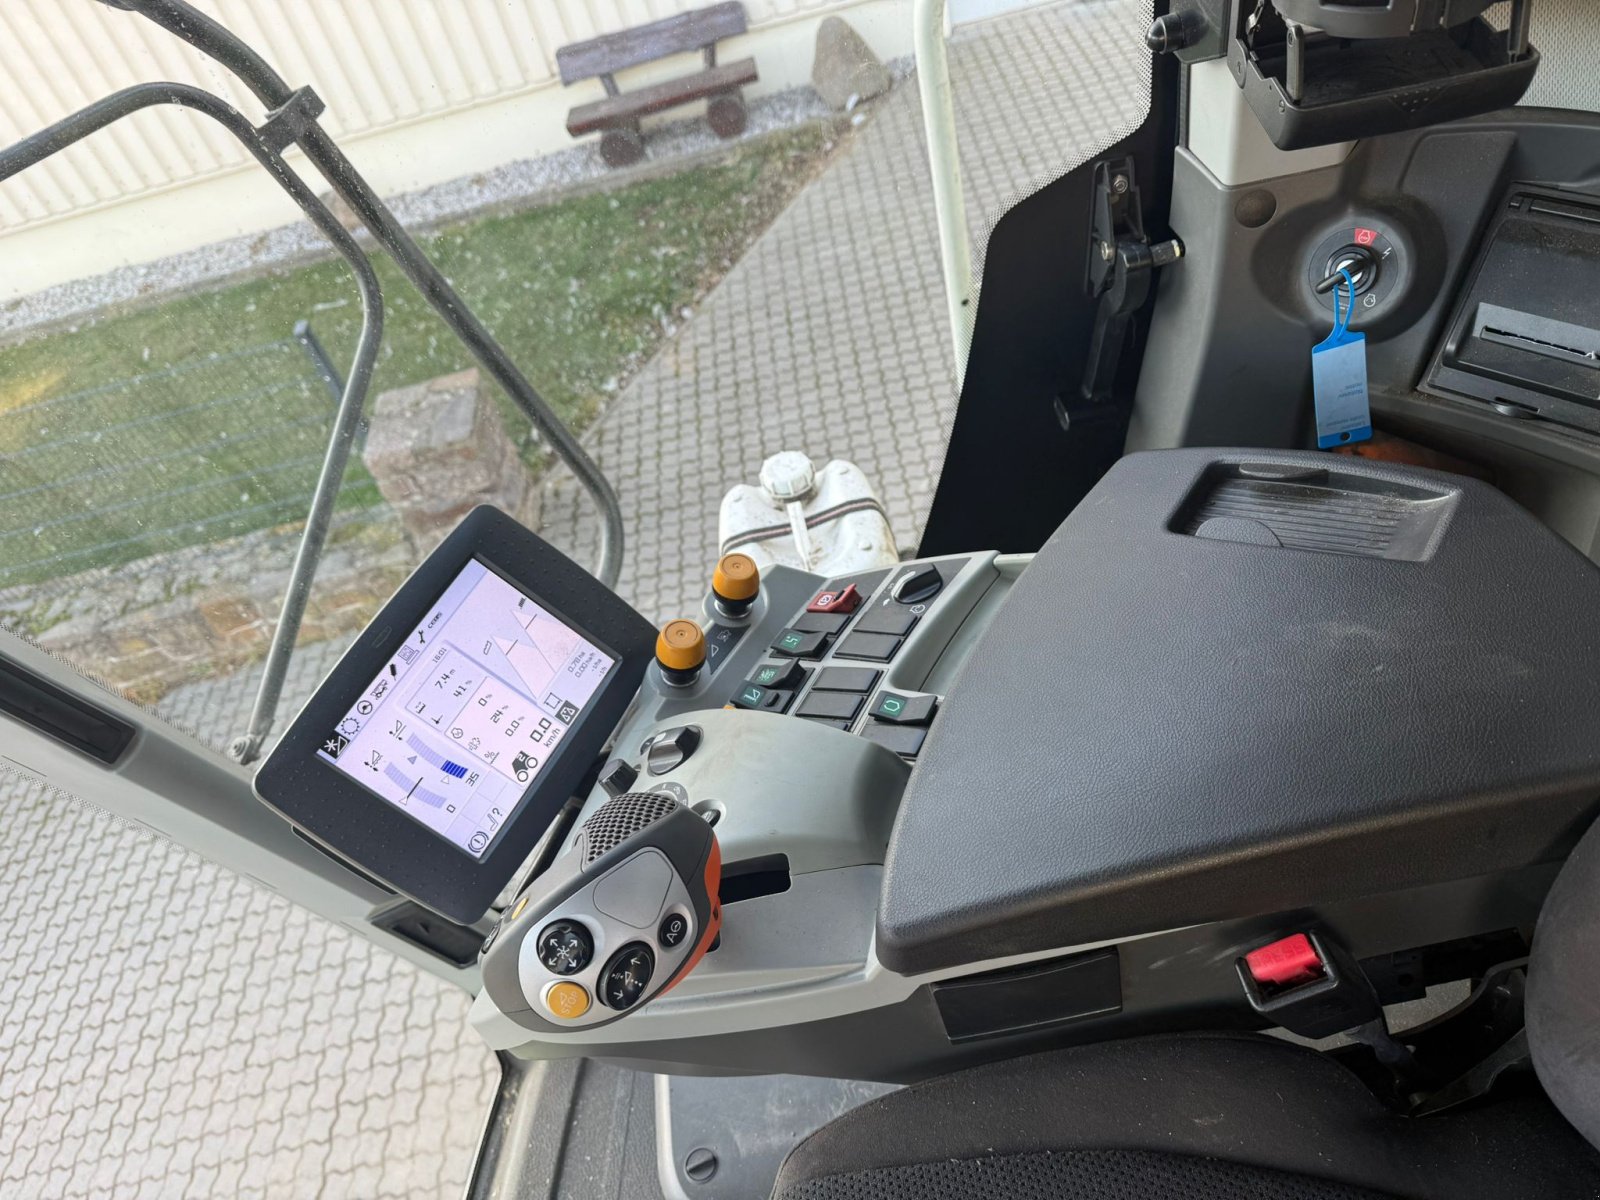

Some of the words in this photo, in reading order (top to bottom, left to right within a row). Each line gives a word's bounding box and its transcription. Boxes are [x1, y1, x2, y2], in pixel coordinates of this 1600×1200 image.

[453, 685, 467, 697] 41
[529, 717, 552, 743] 0.0
[543, 727, 561, 748] km/h
[465, 771, 480, 787] 35
